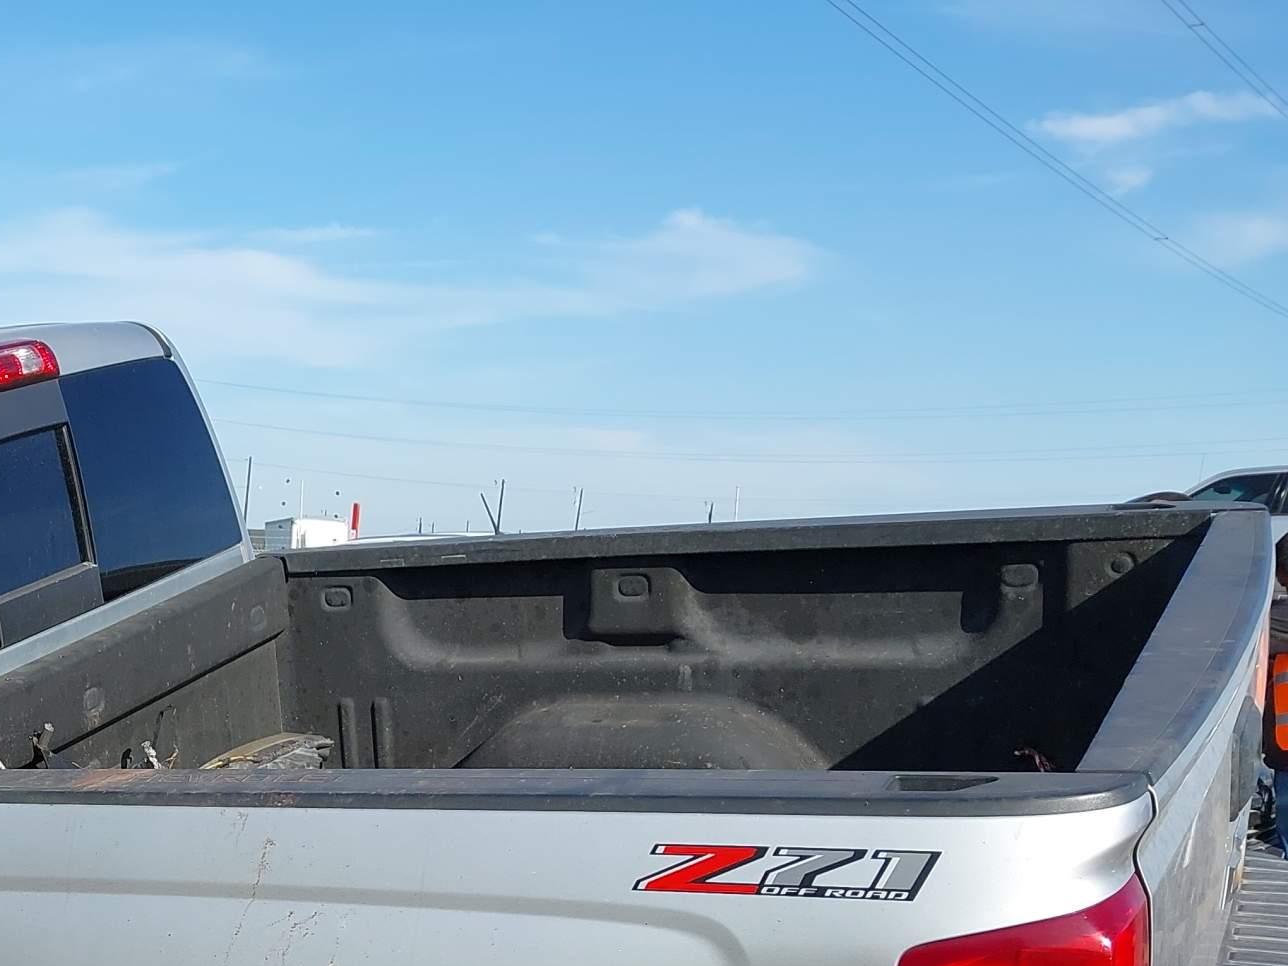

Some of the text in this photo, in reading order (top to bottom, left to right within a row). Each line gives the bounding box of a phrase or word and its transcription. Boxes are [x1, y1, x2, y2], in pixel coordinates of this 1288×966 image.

[632, 843, 942, 898] Z71
[760, 886, 910, 900] OFF ROAD
